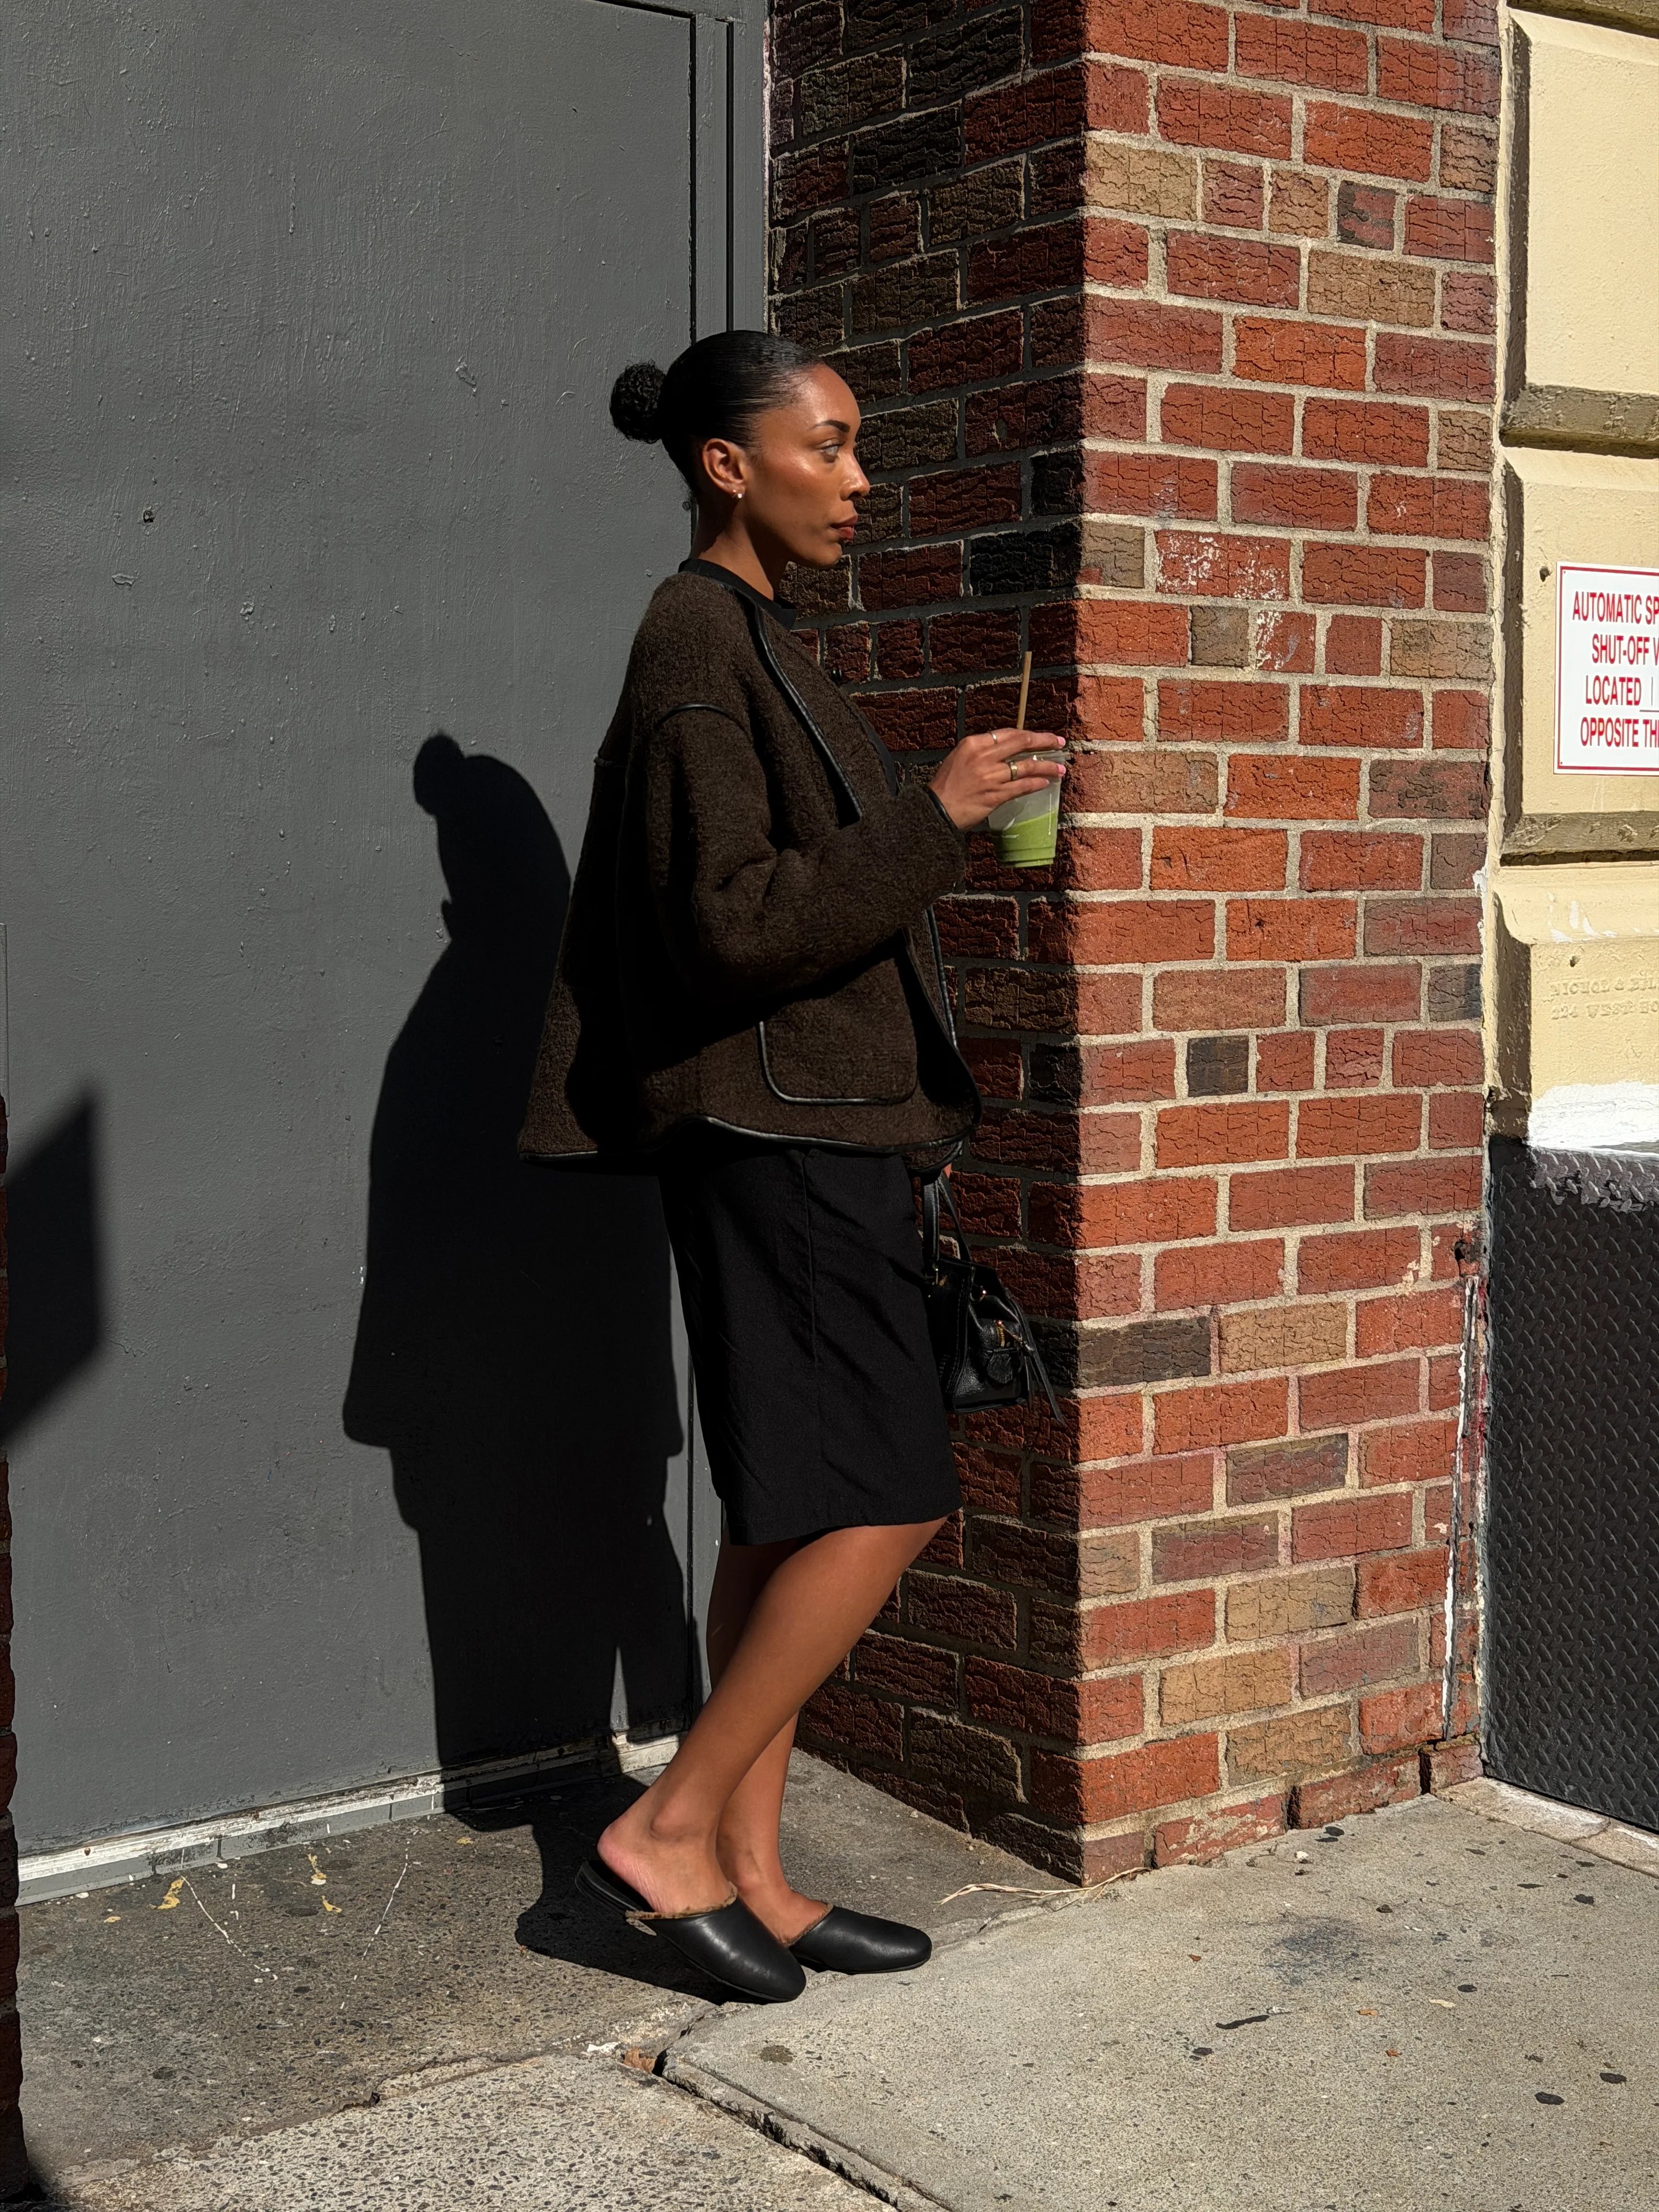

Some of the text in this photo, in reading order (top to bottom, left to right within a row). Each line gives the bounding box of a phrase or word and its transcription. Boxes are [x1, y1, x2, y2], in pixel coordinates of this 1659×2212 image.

[1572, 591, 1659, 625] AUTOMATIC SP
[1592, 633, 1650, 665] SHUT-OFF
[1585, 675, 1642, 706] LOCATED
[1580, 717, 1639, 748] OPPOSITE
